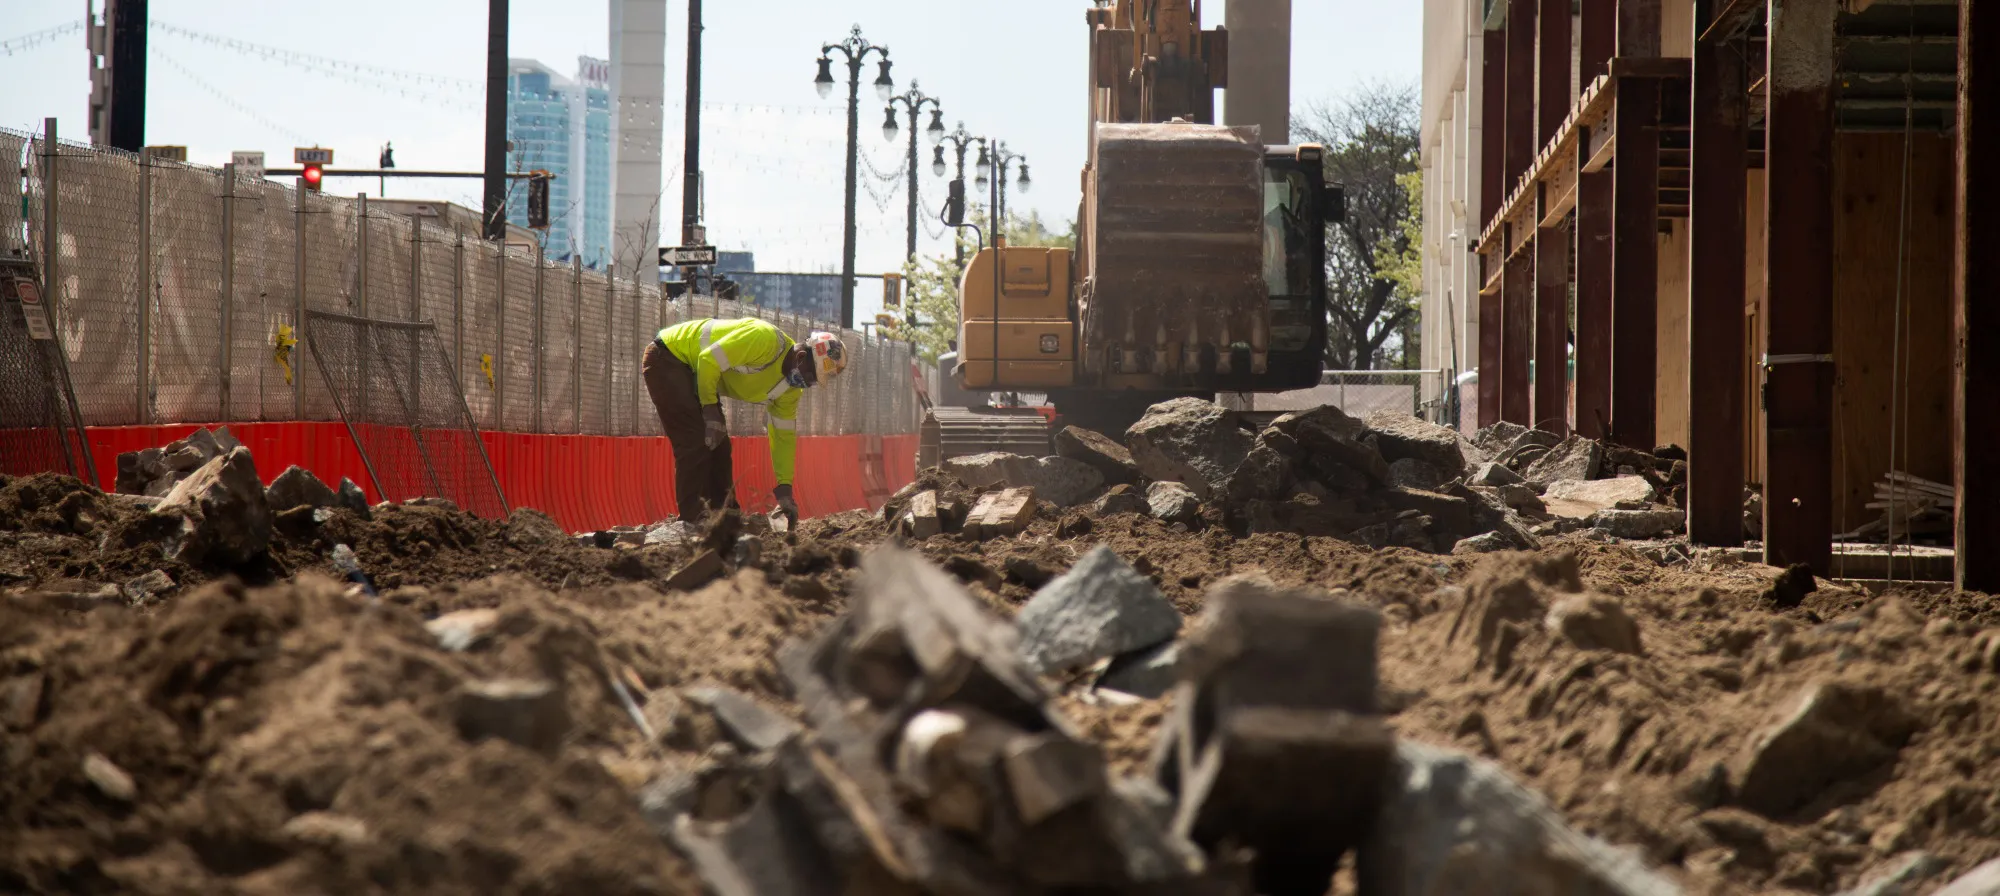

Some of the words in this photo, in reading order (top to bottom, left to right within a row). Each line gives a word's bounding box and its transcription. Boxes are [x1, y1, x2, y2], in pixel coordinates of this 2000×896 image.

[247, 155, 263, 165] NOT
[300, 151, 324, 160] LEFT
[675, 251, 691, 260] ONE
[694, 251, 709, 260] WAY
